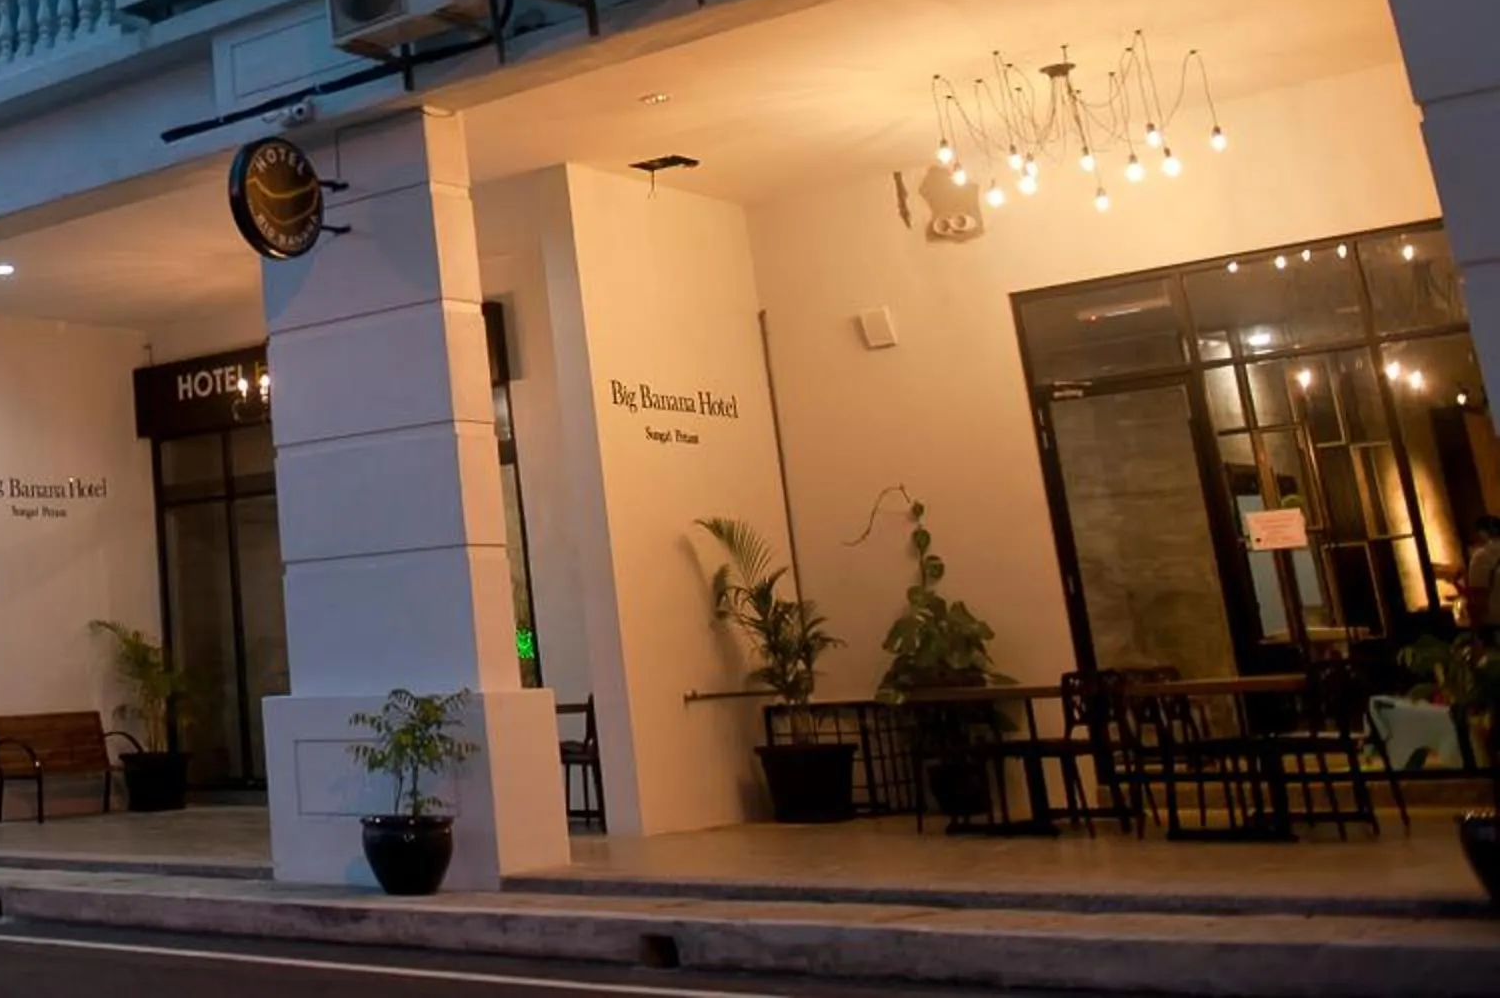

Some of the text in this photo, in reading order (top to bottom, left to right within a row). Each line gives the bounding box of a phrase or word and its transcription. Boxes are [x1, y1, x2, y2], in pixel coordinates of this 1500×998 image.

[255, 147, 305, 176] HOTEL
[610, 380, 739, 419] Big Banana Hotel
